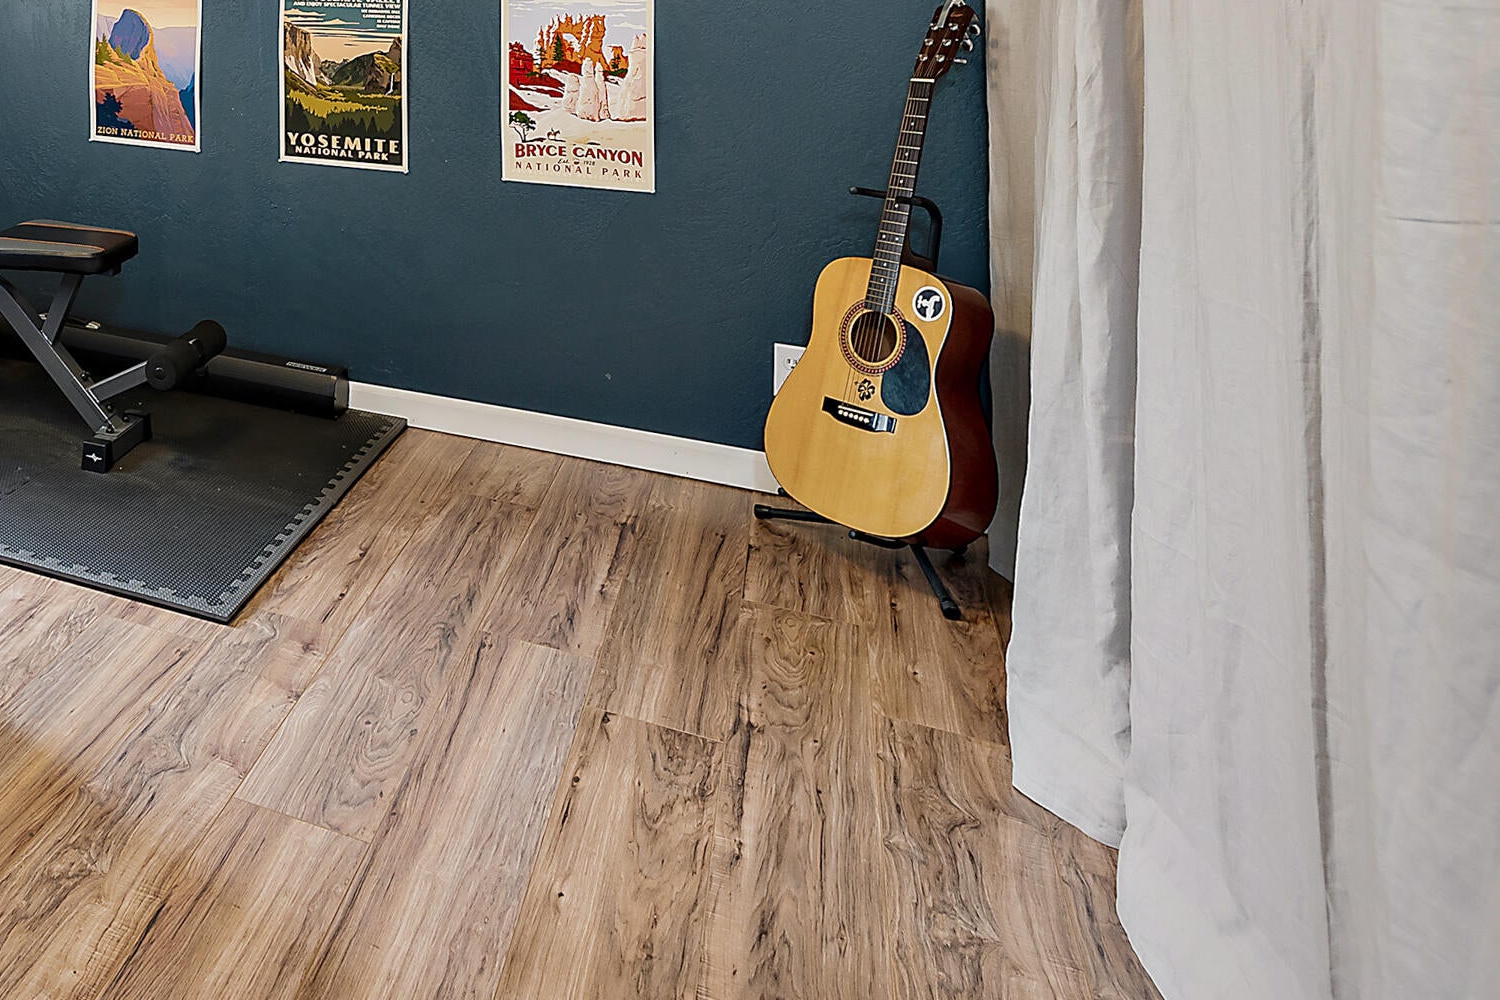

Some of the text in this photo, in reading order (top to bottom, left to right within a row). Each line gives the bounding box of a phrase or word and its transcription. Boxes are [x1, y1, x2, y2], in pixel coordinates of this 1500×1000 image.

[97, 126, 194, 143] ZION NATIONAL PARK
[286, 131, 399, 154] YOSEMITE
[295, 145, 389, 160] NATIONAL PARK
[515, 143, 643, 168] BRYCE CANYON
[515, 161, 642, 178] NATIONAL PARK
